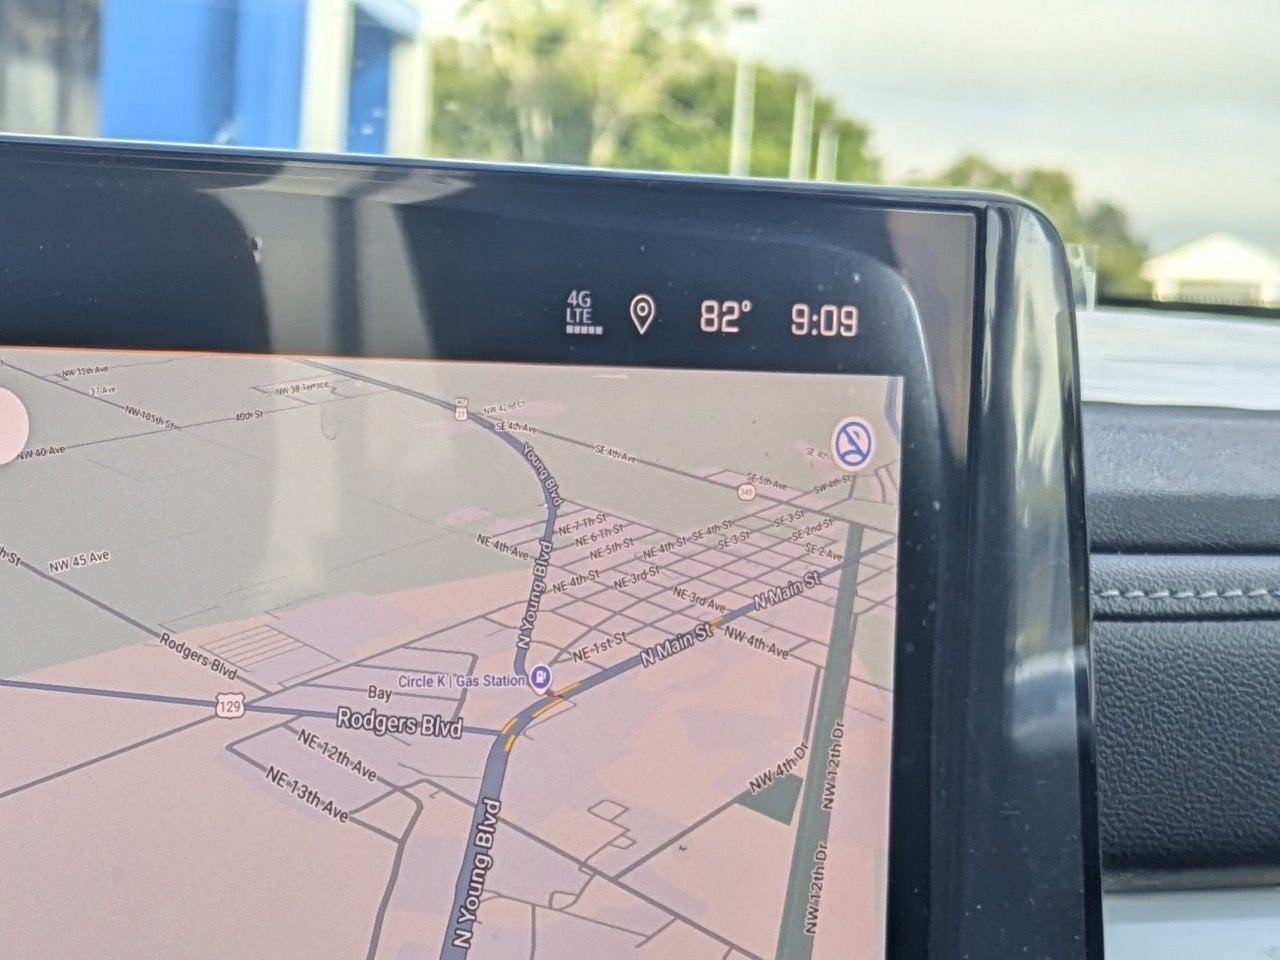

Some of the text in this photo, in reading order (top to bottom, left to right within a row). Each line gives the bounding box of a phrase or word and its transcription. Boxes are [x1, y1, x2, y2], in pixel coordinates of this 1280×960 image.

[567, 290, 591, 307] 4G
[566, 308, 592, 323] LTE
[700, 299, 752, 333] 82°
[791, 303, 859, 336] 9:09
[124, 405, 141, 417] NW
[496, 421, 538, 434] SE 4th Ave
[34, 447, 47, 457] 40
[49, 445, 66, 455] Ave
[595, 444, 637, 463] SE 4th Ave
[523, 442, 564, 507] Young Blvd
[746, 473, 756, 482] SE
[773, 480, 788, 491] Ave
[813, 484, 827, 495] SW
[558, 524, 573, 536] NE
[596, 514, 607, 526] St
[692, 519, 733, 541] SE 4th St
[773, 517, 786, 528] SE
[795, 509, 805, 520] St
[791, 518, 834, 542] SE 2nd St
[477, 534, 529, 561] NE 4th Ave
[575, 535, 590, 548] NE
[612, 524, 624, 536] St
[718, 539, 730, 550] SE
[739, 531, 751, 541] St
[6, 552, 21, 567] St
[589, 538, 634, 561] NE 5th St
[643, 537, 687, 560] NE 4th St
[805, 543, 818, 554] SE
[826, 549, 843, 561] Ave
[49, 550, 110, 573] NW 45 Ave
[553, 569, 600, 594] NE 4th St
[613, 565, 661, 591] NE 3rd St
[517, 541, 553, 650] N Young Blvd
[673, 586, 726, 613] NE 3rd Ave
[754, 570, 821, 611] N Main St
[573, 631, 627, 663] NE 1st St
[640, 621, 714, 667] N Main St
[724, 625, 789, 660] NW 4th Ave
[160, 633, 237, 681] Rodgers Blvd
[399, 674, 525, 689] Circle K Gas Station
[368, 685, 392, 703] Bay
[220, 701, 241, 714] 129
[337, 706, 464, 739] Rodgers Blvd
[297, 729, 377, 782] NE 12th Ave
[748, 740, 809, 795] NW 4th Dr
[822, 721, 845, 810] NW 12th Dr
[265, 766, 349, 824] NE 13th Ave
[453, 798, 501, 948] N Young Blvd
[806, 842, 828, 935] NW 12th Dr
